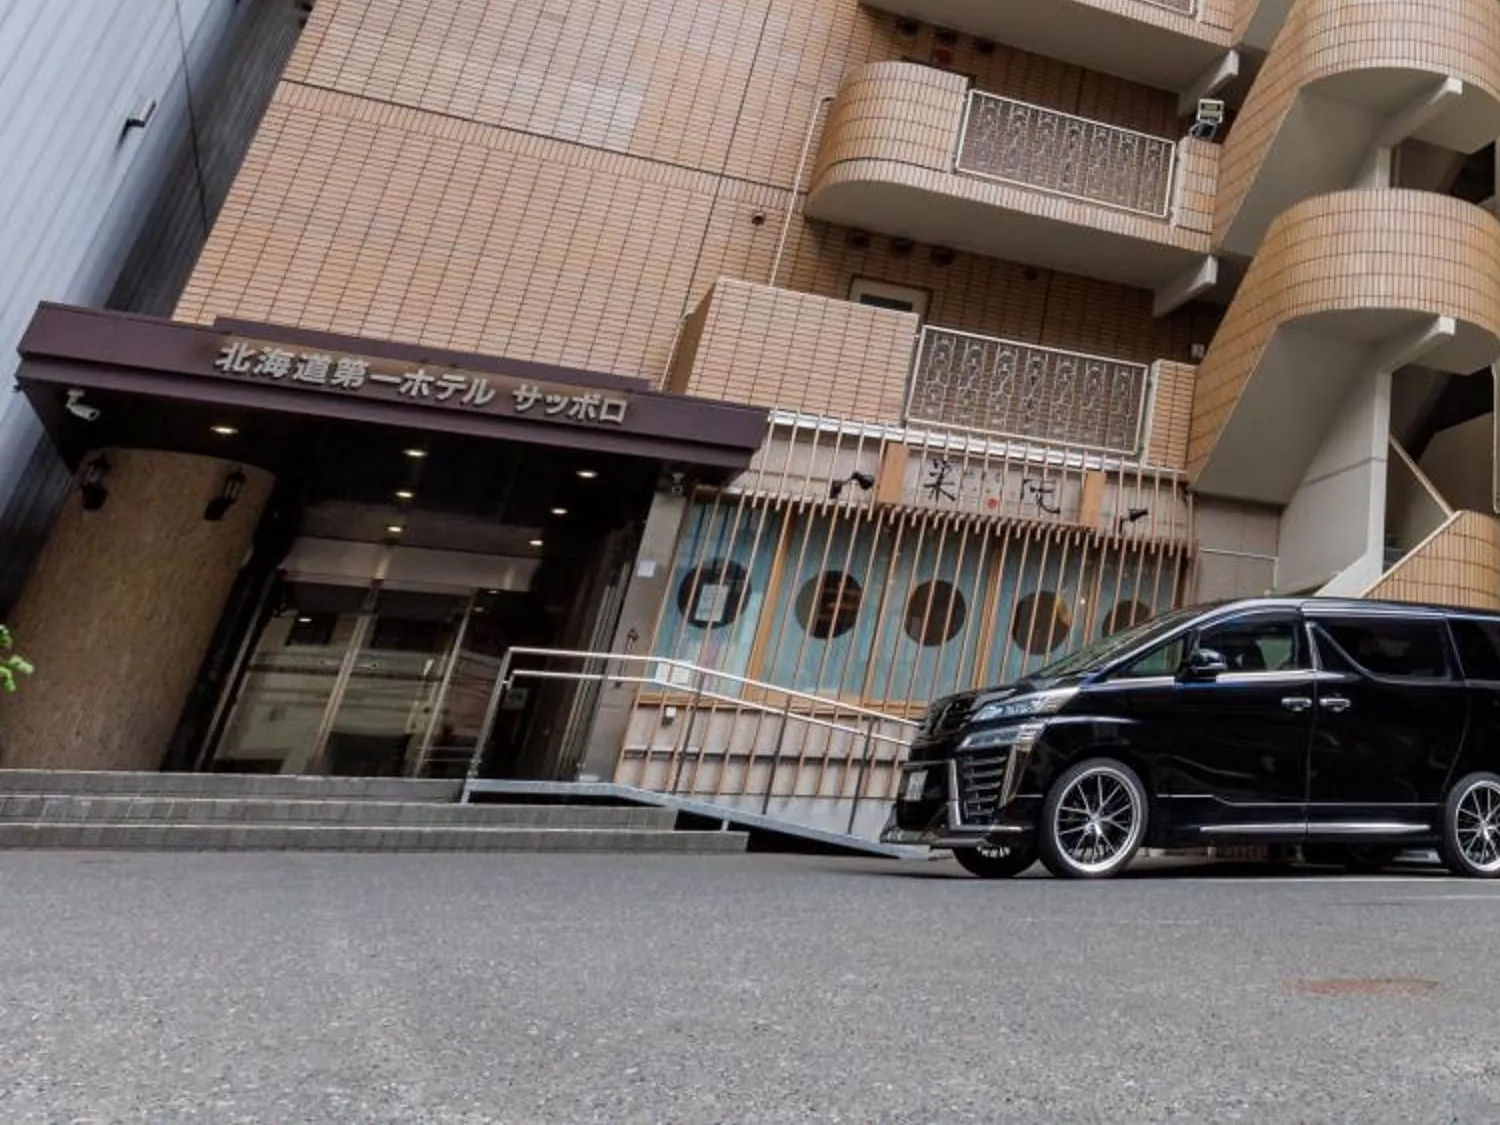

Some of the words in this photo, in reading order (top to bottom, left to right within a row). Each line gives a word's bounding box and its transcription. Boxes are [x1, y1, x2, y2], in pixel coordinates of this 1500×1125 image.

[214, 343, 495, 405] 北海道第一ホテル
